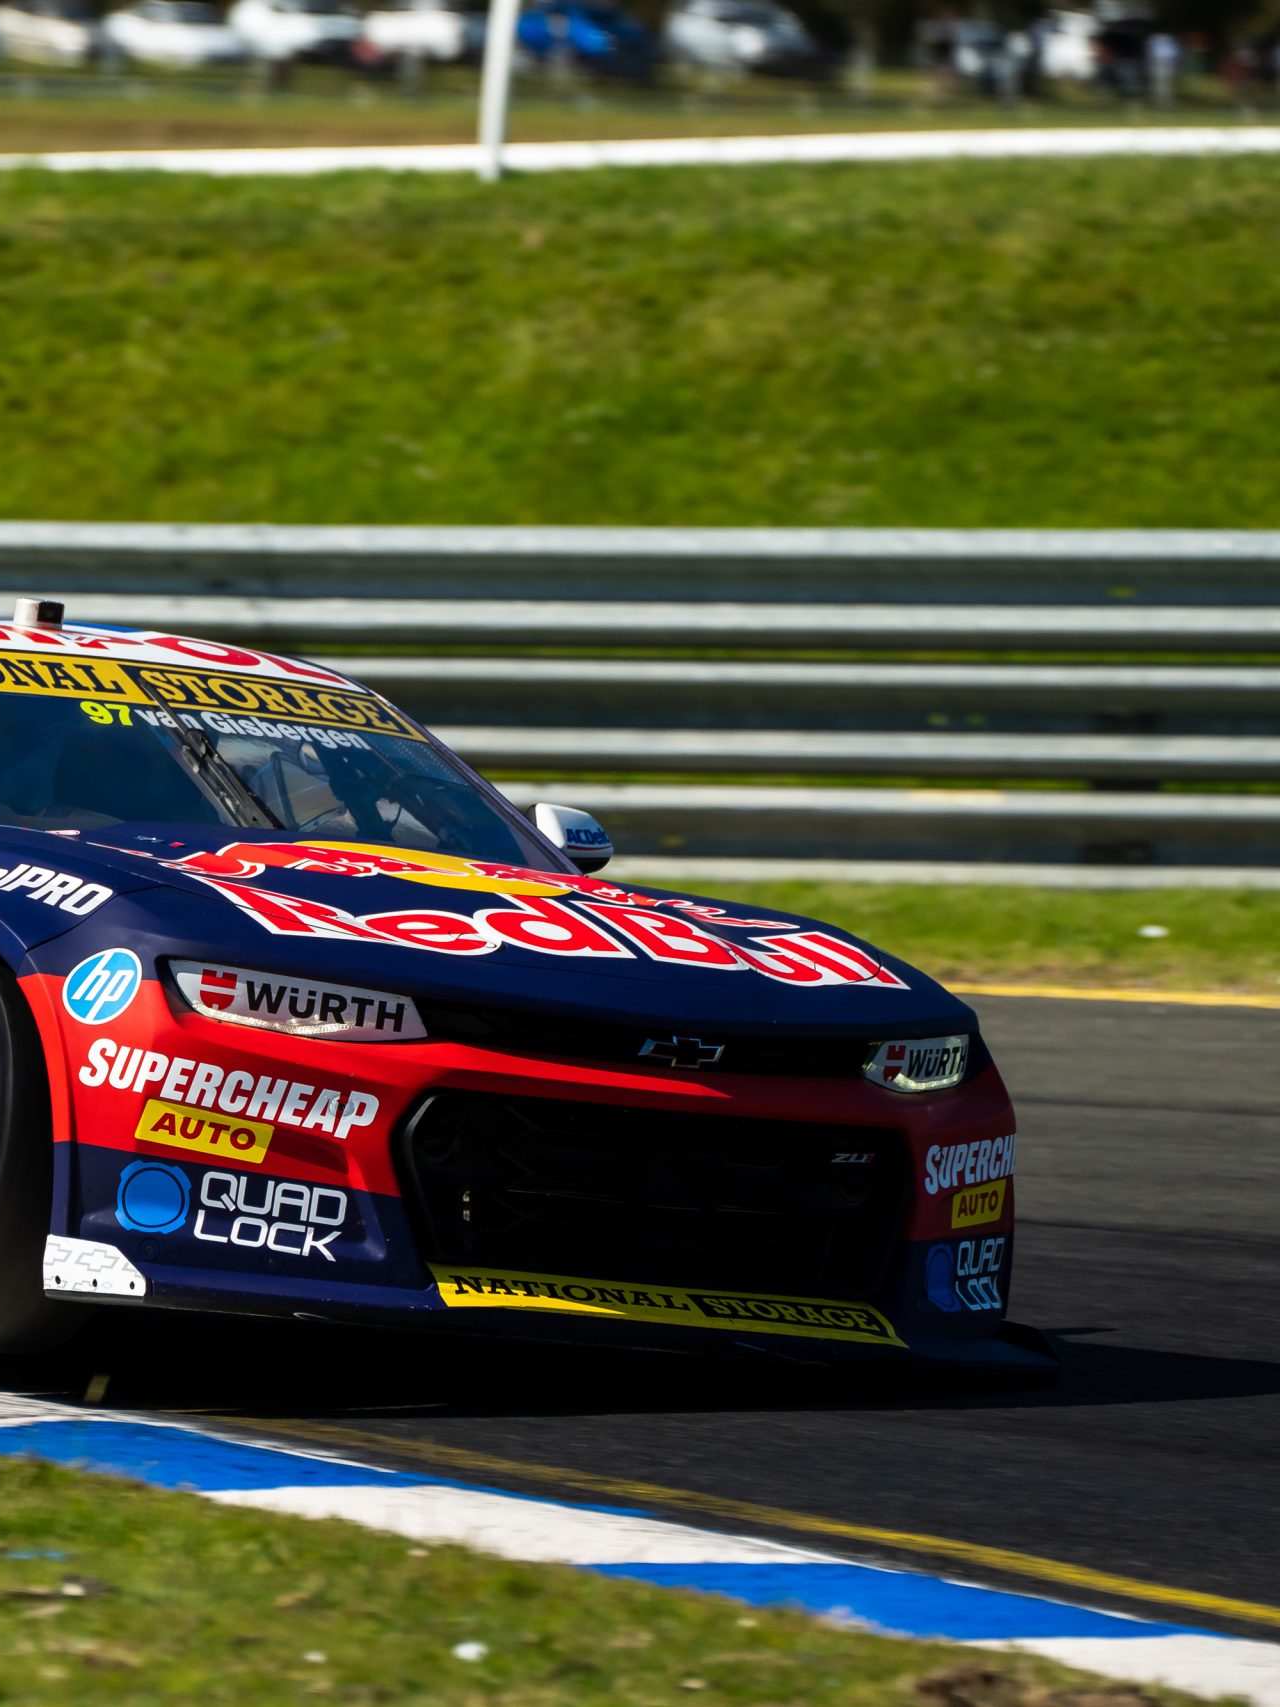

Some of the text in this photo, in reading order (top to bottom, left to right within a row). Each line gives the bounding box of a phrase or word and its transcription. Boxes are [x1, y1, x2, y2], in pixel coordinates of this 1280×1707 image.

[80, 701, 372, 750] 97 van Gisbergen
[140, 670, 398, 731] STORAGE
[180, 872, 637, 958] Red
[71, 951, 135, 1021] hp
[79, 1038, 379, 1140] SUPERCHEAP
[150, 1112, 256, 1151] AUTO
[200, 1171, 347, 1226] QUAD
[957, 1190, 998, 1217] AUTO
[193, 1210, 342, 1262] LOCK
[957, 1238, 1005, 1276] QUAD
[449, 1274, 880, 1332] NATIONAL STORAGE
